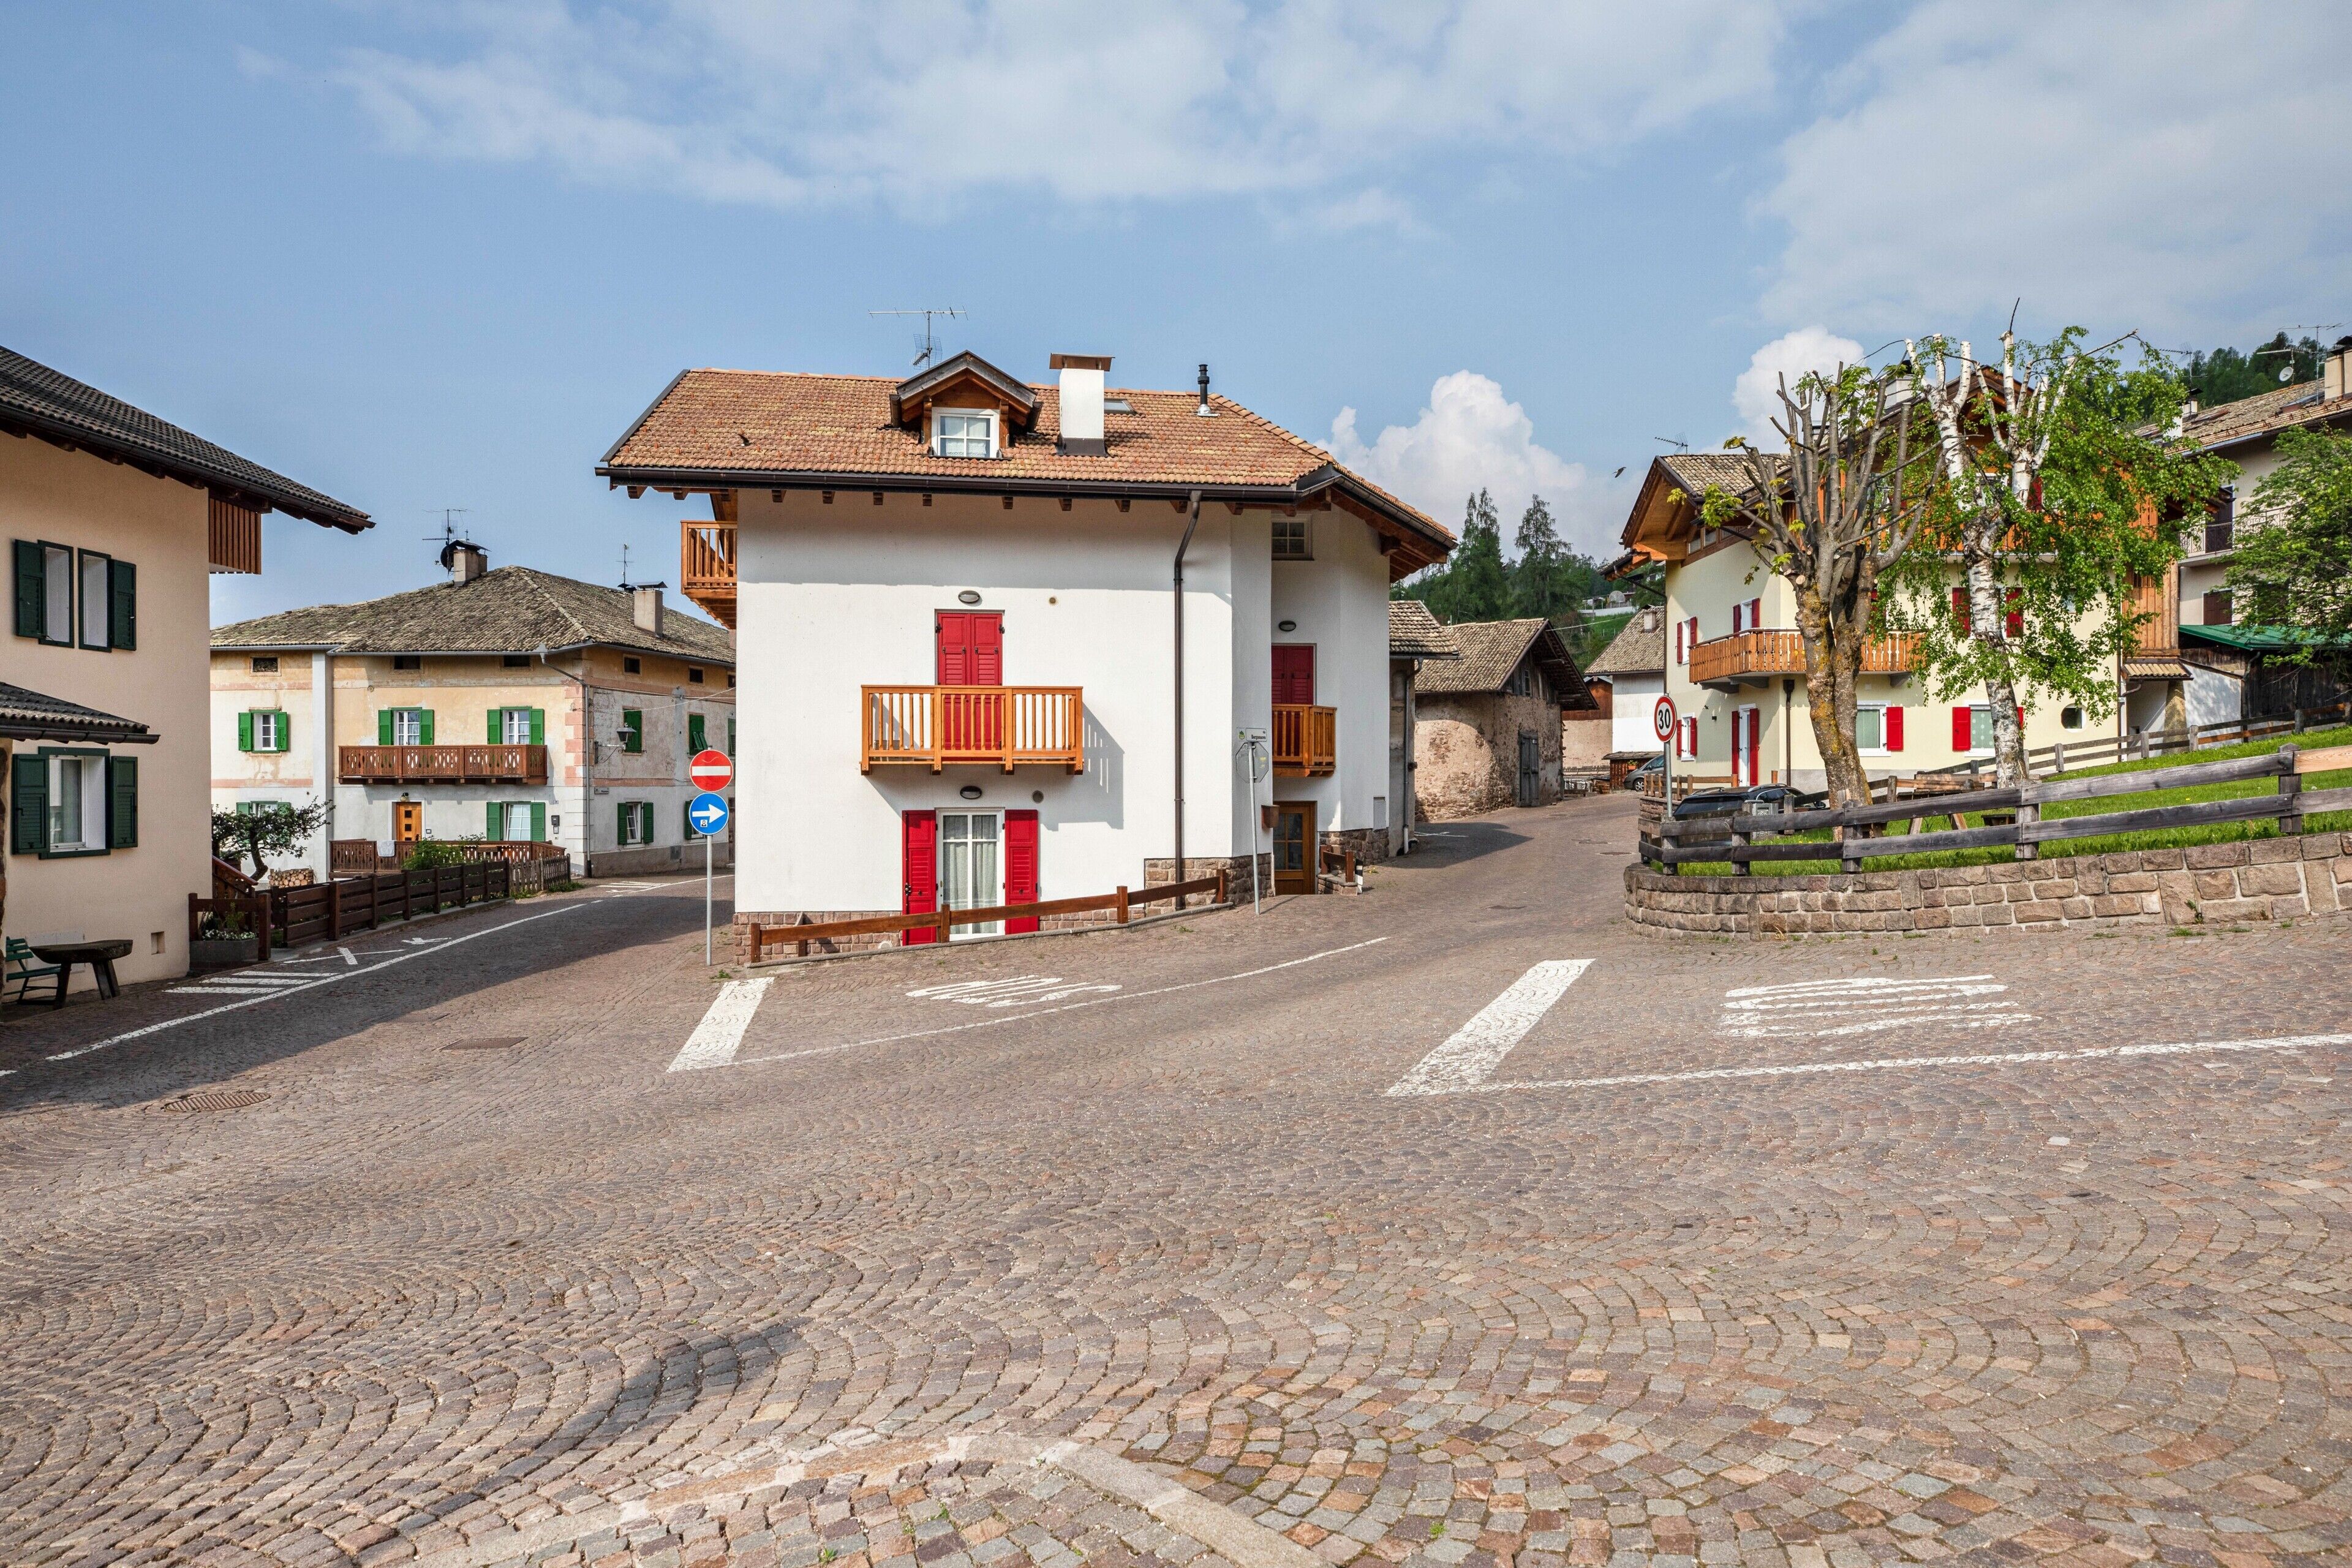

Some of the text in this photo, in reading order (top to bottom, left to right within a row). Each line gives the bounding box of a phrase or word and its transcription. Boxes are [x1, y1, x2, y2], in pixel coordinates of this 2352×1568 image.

[1659, 708, 1670, 729] 30
[905, 974, 1122, 1008] STOP
[1717, 974, 2043, 1036] STOP
